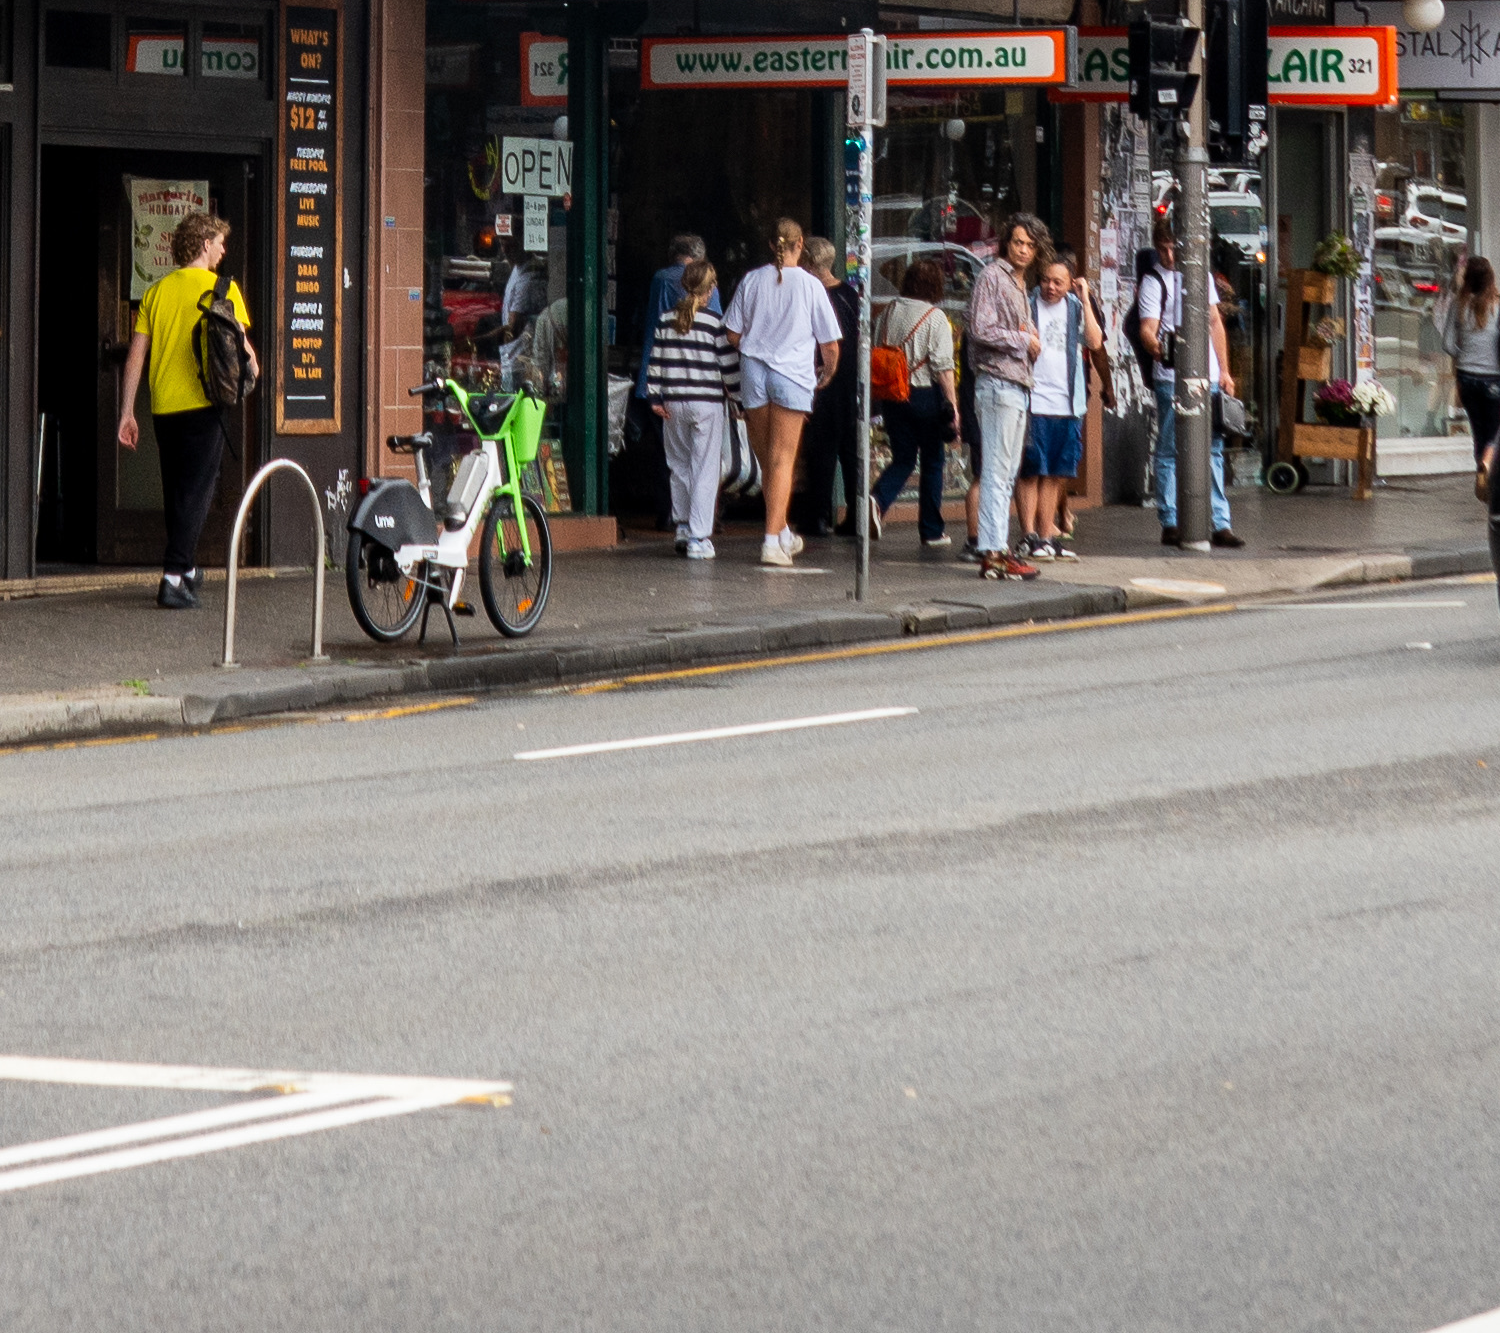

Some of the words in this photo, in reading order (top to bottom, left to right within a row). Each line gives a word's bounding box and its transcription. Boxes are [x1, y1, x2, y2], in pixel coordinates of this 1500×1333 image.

[290, 27, 329, 47] WHAT'S
[1396, 32, 1450, 58] STAL
[300, 52, 322, 70] ON?
[1348, 58, 1373, 75] 321
[289, 103, 316, 132] $12
[289, 158, 307, 171] FREE
[308, 159, 328, 173] POOL
[504, 145, 572, 190] OPEN
[137, 188, 204, 207] Margarita
[299, 197, 315, 210] LIVE
[148, 203, 193, 217] MONDAYS
[296, 213, 320, 228] MUSIC
[297, 263, 318, 277] DRAG
[295, 280, 320, 294] BINGO
[292, 336, 323, 350] ROOFTOP
[307, 366, 323, 379] LATE
